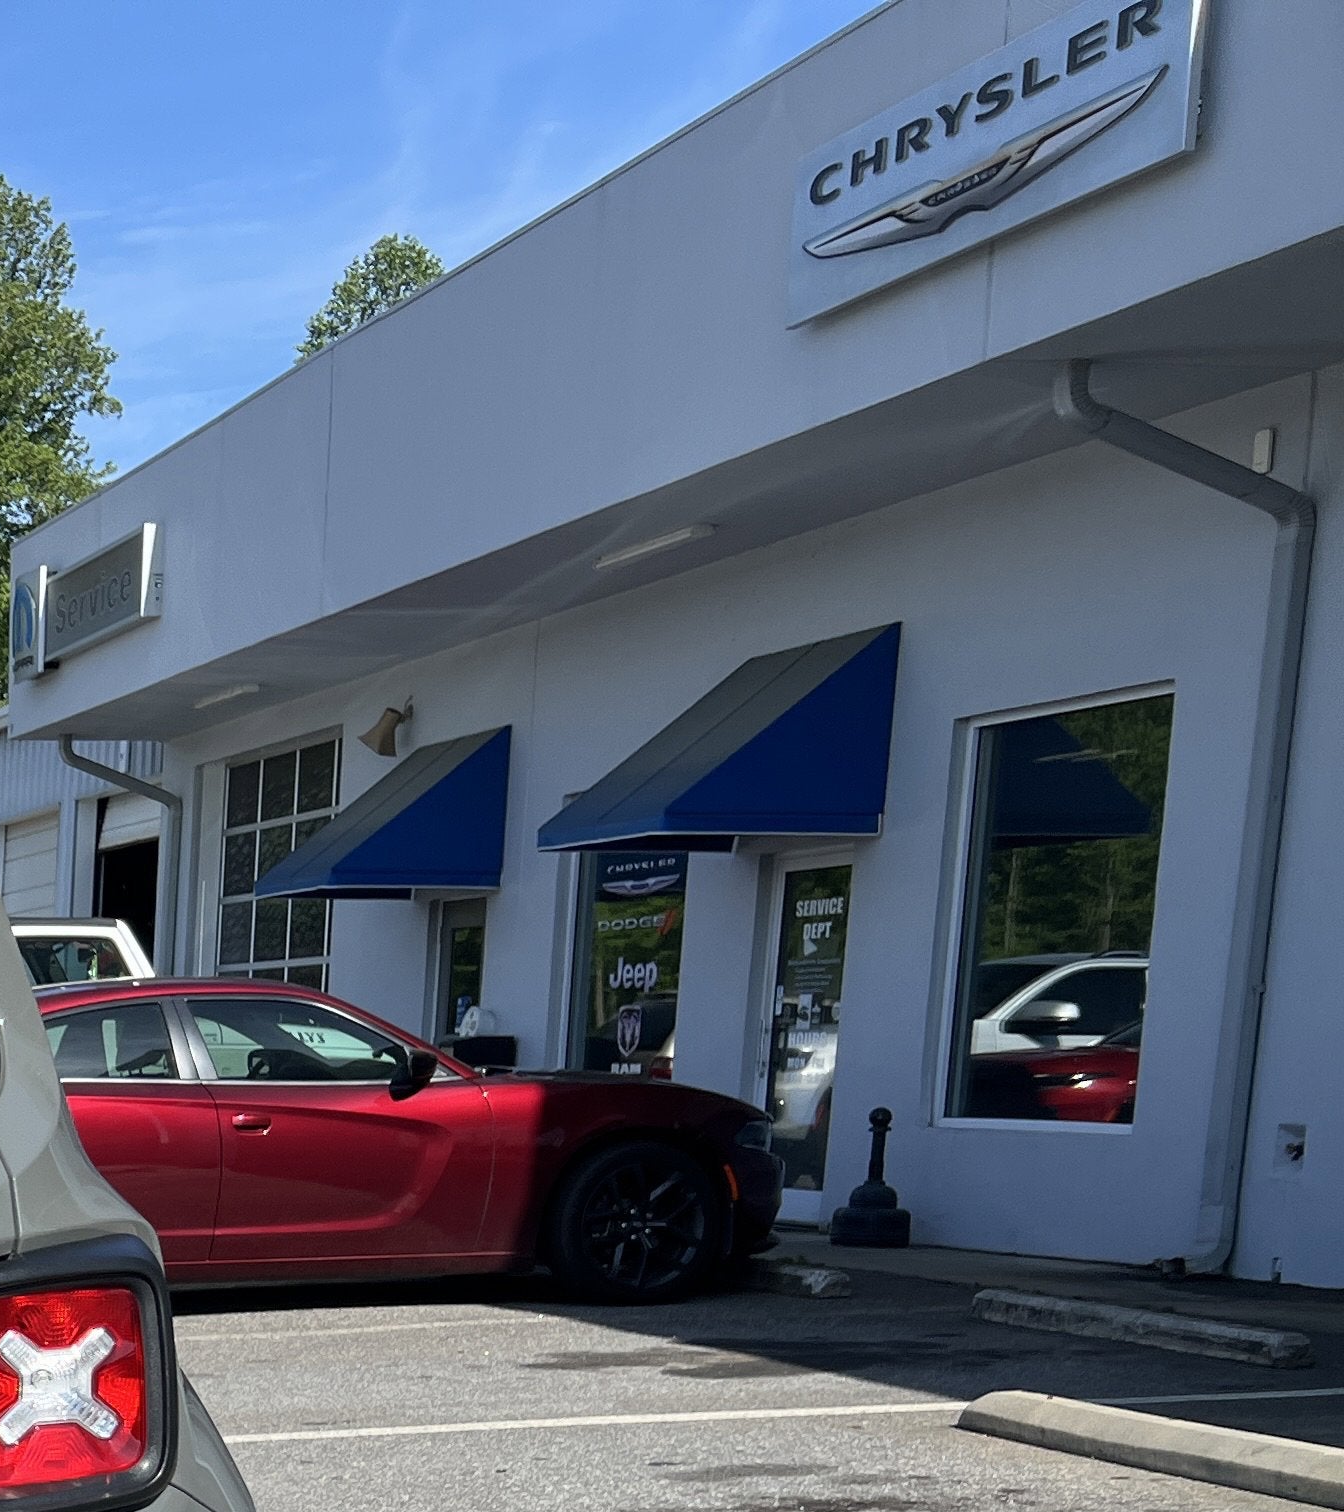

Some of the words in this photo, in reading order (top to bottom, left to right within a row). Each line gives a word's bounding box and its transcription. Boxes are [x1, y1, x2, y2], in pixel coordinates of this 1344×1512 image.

[809, 0, 1164, 205] CHRYSLER
[54, 570, 133, 634] Service
[795, 896, 844, 917] SERVICE
[803, 921, 832, 940] DEPT
[609, 957, 658, 992] Jeep
